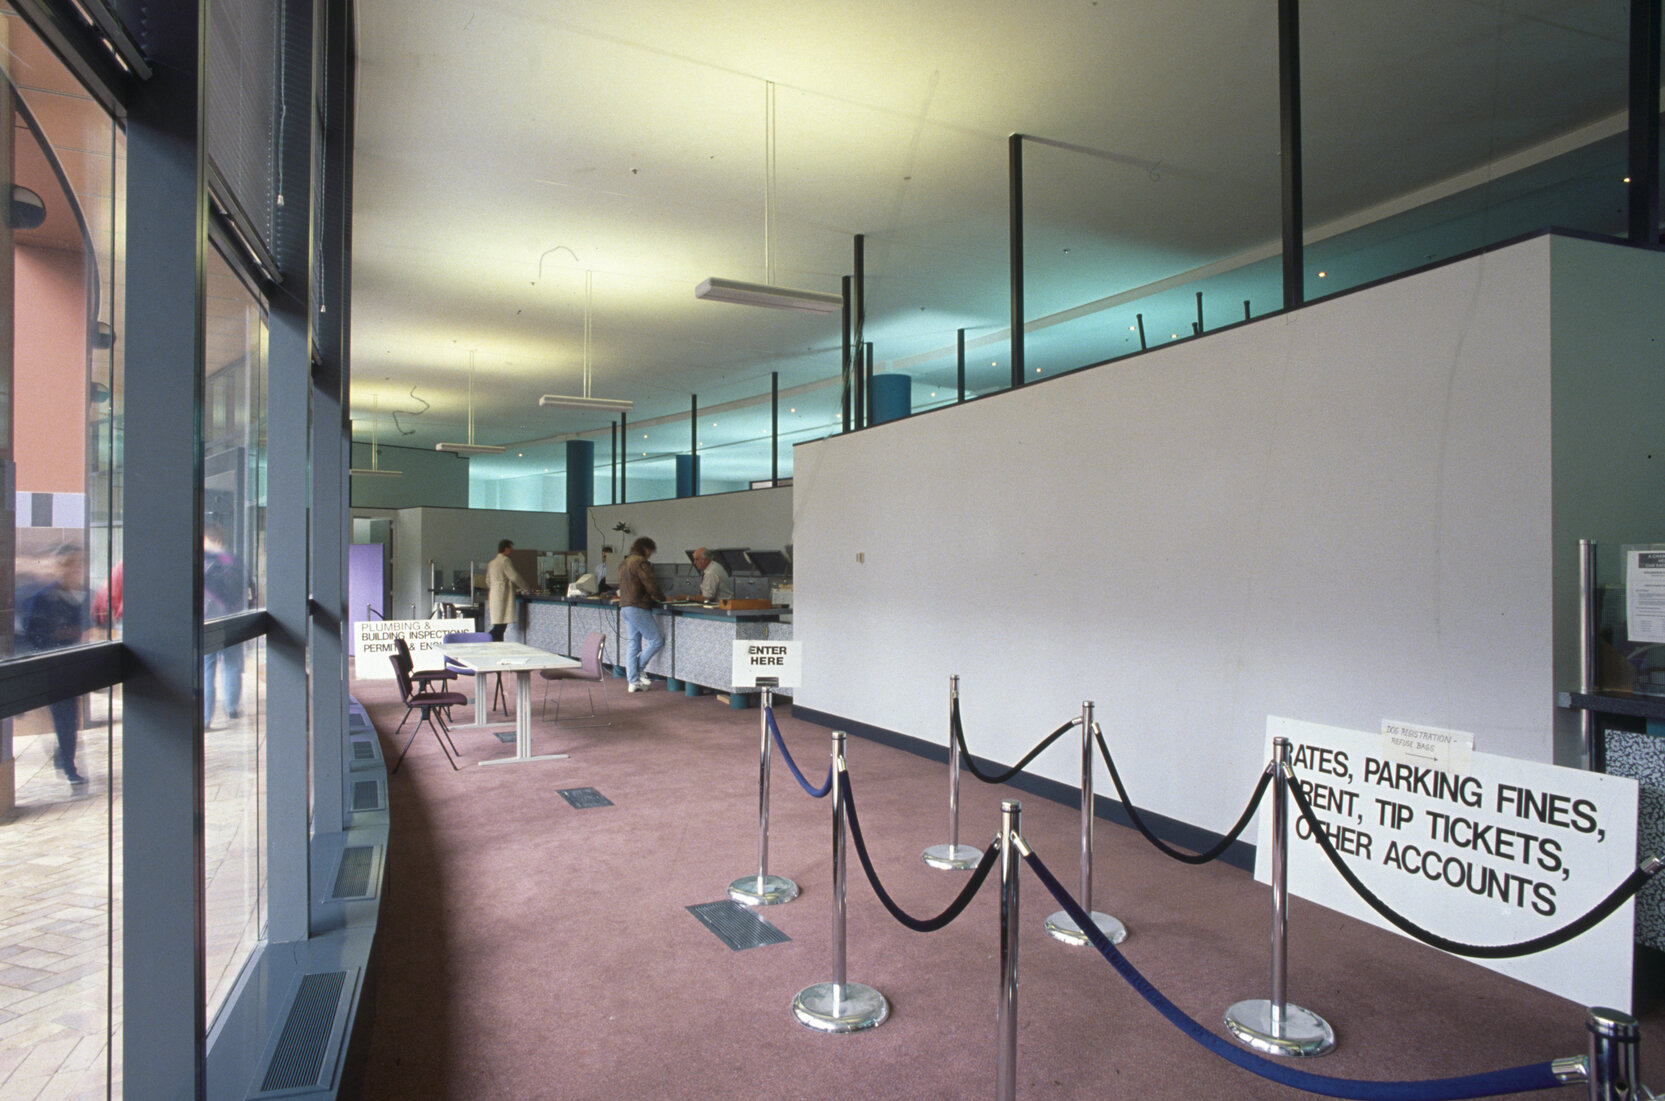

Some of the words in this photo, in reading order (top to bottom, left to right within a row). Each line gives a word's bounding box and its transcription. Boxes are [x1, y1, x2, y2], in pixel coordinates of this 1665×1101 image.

[361, 621, 420, 632] PLUMBING
[424, 621, 431, 630] &
[361, 631, 405, 641] BUILDING
[363, 643, 399, 653] PERMIT
[748, 645, 787, 655] ENTER
[750, 656, 784, 666] HERE
[1364, 757, 1482, 808] PARKING
[1497, 783, 1605, 844] FINES,
[1375, 798, 1414, 831] TIP
[1426, 810, 1570, 882] TICKETS,
[1383, 841, 1557, 917] ACCOUNTS
